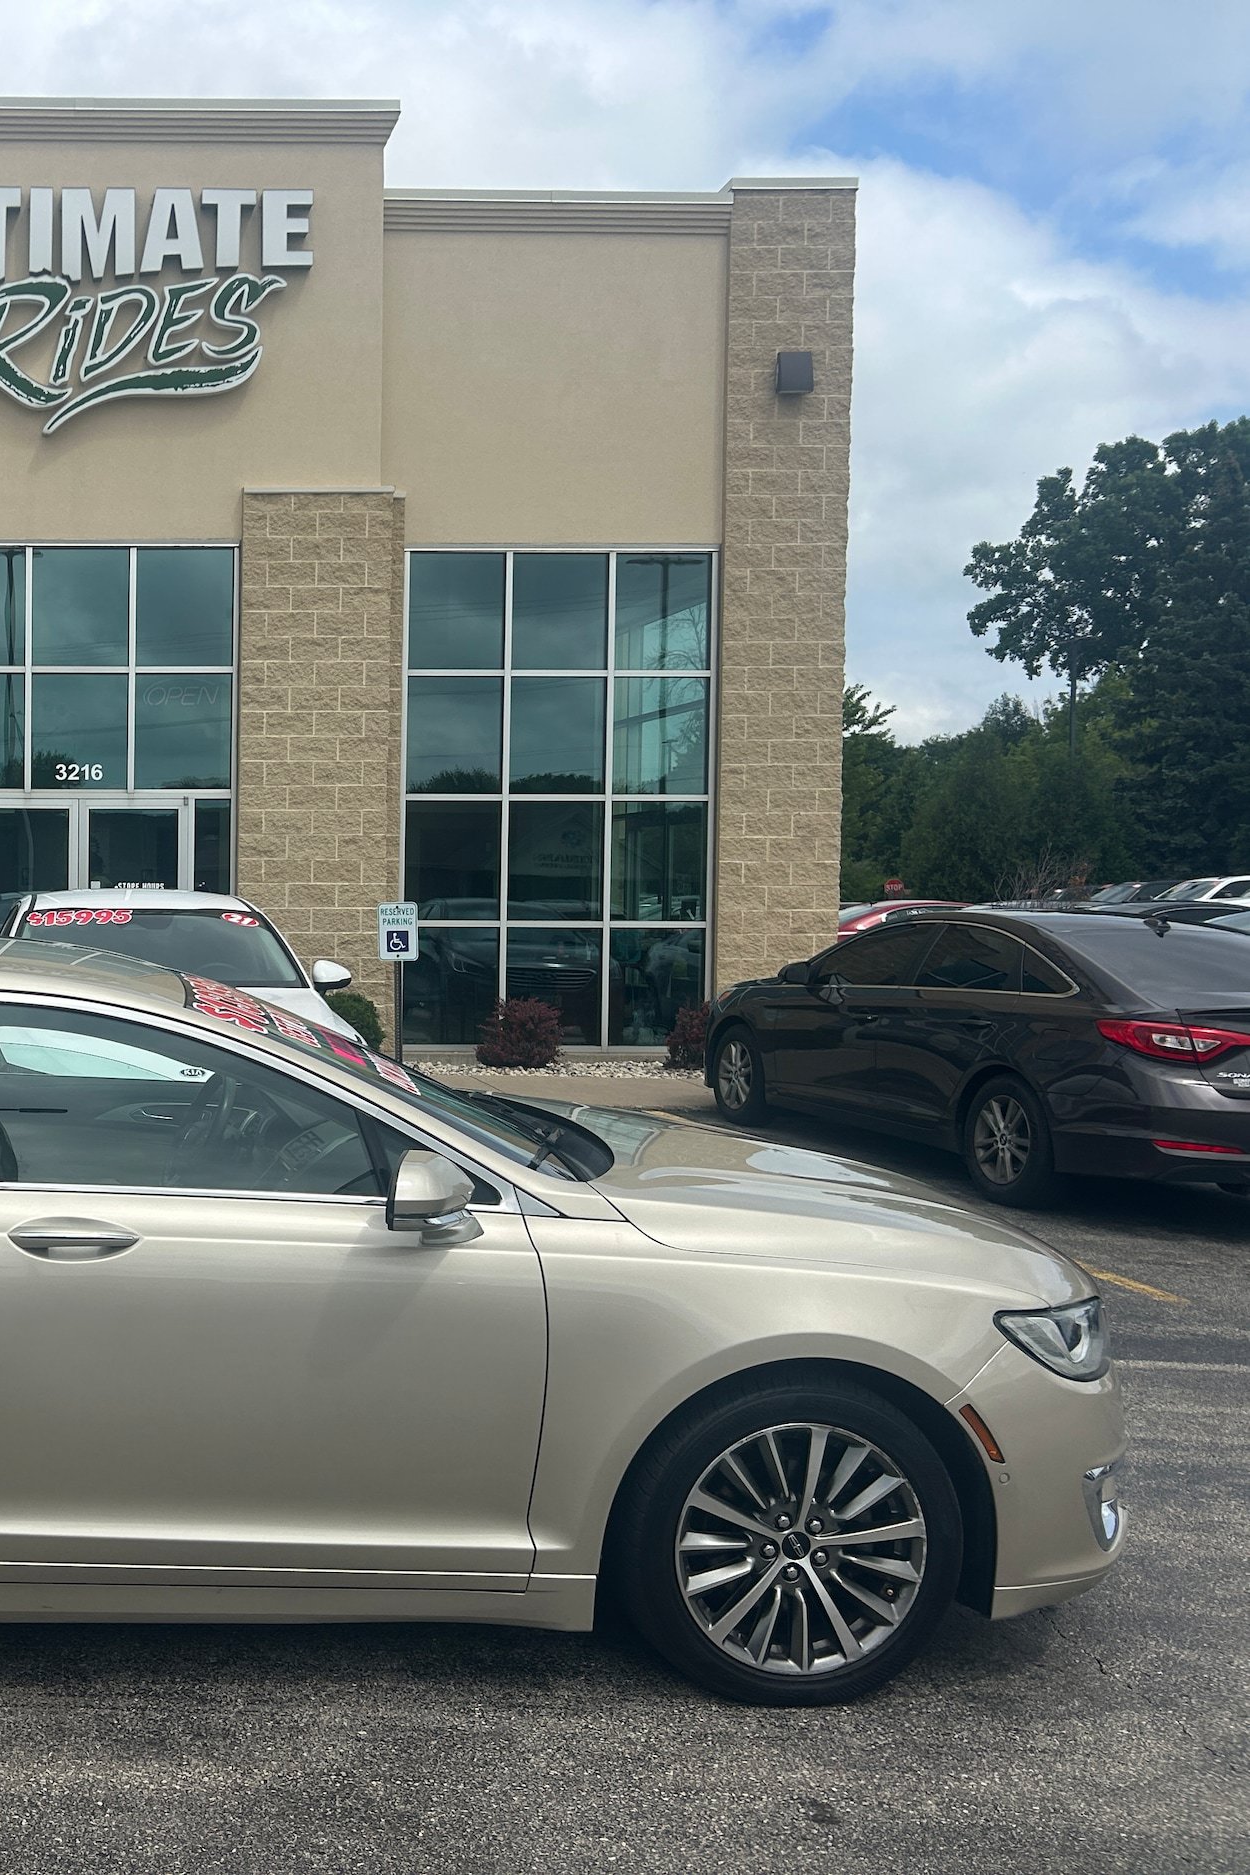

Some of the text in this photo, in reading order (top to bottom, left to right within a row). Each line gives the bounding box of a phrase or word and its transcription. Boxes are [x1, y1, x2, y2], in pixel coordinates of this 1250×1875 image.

[147, 686, 219, 706] OPEN
[55, 763, 103, 781] 3216
[886, 883, 903, 891] STOP
[380, 907, 415, 916] RESERVED
[26, 909, 133, 926] $15995
[382, 917, 413, 926] PARKING
[183, 1068, 203, 1077] KIA
